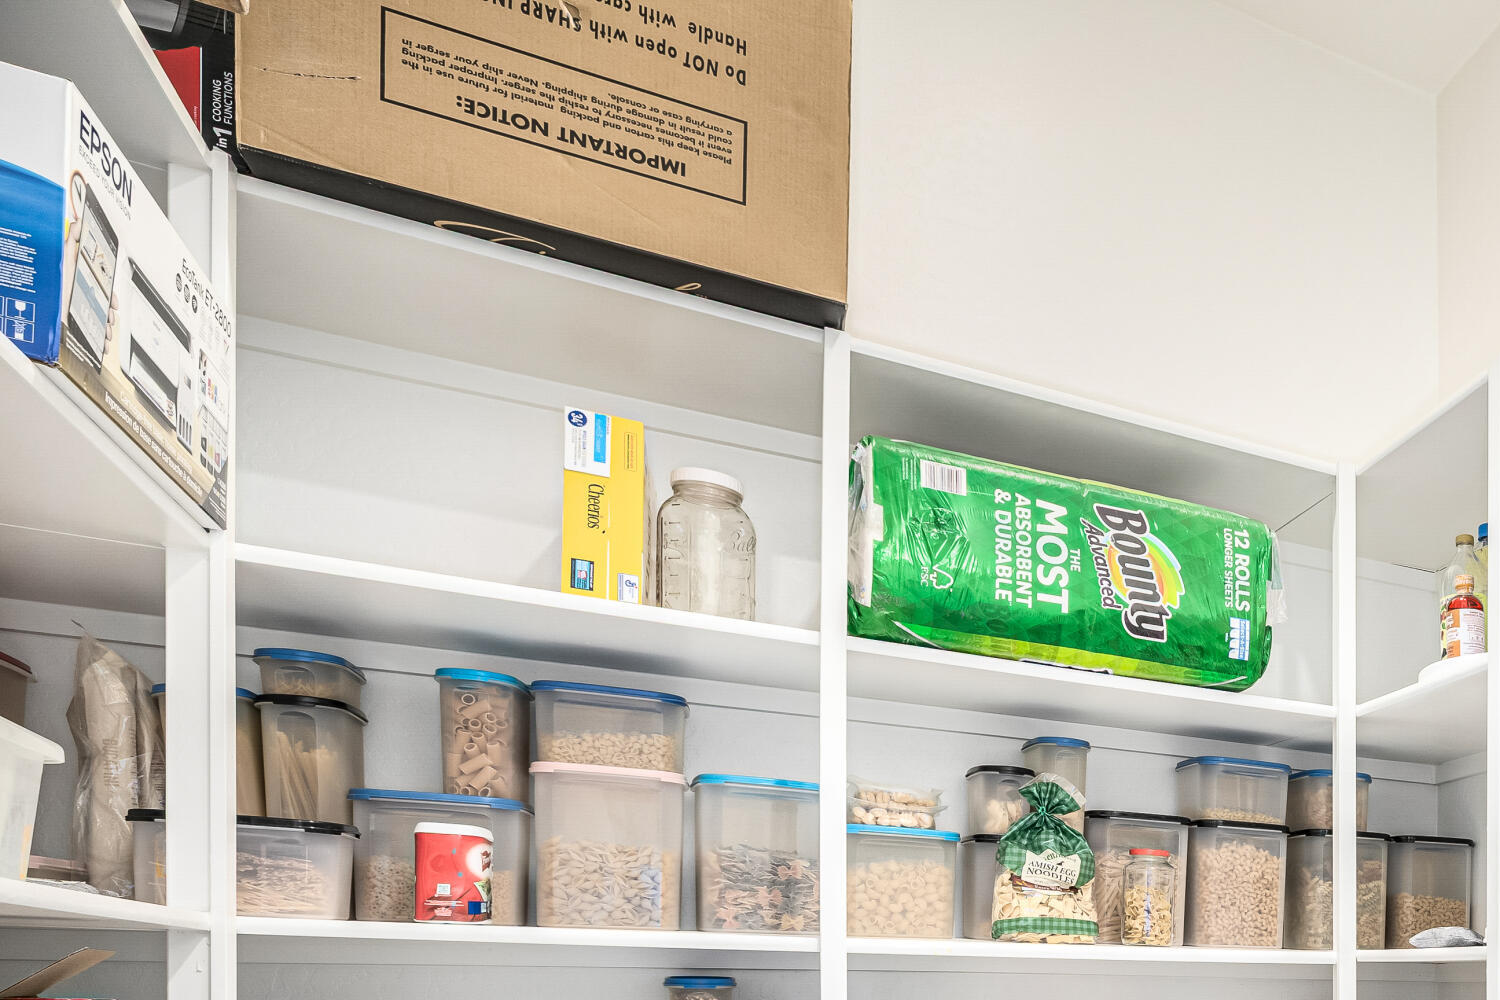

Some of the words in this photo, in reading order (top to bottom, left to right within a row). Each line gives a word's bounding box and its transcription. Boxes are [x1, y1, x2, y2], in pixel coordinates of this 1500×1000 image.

[521, 1, 581, 32] SHARP
[638, 4, 676, 28] with
[589, 20, 628, 43] with
[688, 21, 747, 56] Handle
[402, 38, 412, 49] in
[415, 43, 450, 58] serger
[635, 35, 677, 58] open
[401, 59, 419, 70] the
[402, 47, 446, 67] packing
[453, 55, 479, 67] your
[683, 52, 719, 77] NOT
[423, 65, 433, 75] in
[436, 70, 454, 80] use
[448, 64, 498, 85] Improper
[482, 63, 504, 76] ship
[725, 65, 746, 86] Do
[458, 76, 490, 92] future
[501, 79, 536, 95] serger.
[507, 72, 538, 88] Never
[212, 79, 222, 122] COOKING
[223, 72, 233, 125] FUNCTIONS
[492, 87, 508, 98] for
[511, 92, 554, 110] material
[539, 91, 555, 102] the
[542, 82, 588, 102] shipping.
[558, 96, 589, 111] reship
[591, 96, 623, 113] during
[608, 93, 647, 110] console.
[456, 95, 549, 137] NOTICE:
[560, 106, 600, 124] packing
[592, 108, 602, 116] to
[605, 110, 652, 130] necessary
[626, 108, 665, 126] damage
[662, 111, 683, 121] case
[603, 120, 622, 130] and
[625, 127, 655, 140] carton
[668, 121, 677, 131] in
[679, 125, 705, 137] result
[686, 116, 724, 133] carrying
[655, 125, 696, 146] becomes
[658, 137, 674, 147] this
[698, 140, 704, 148] it
[708, 134, 732, 145] could
[557, 127, 686, 177] IMPORTANT
[677, 142, 700, 156] keep
[707, 143, 732, 154] event
[79, 109, 134, 207] EPSON
[703, 151, 732, 165] Please
[181, 258, 205, 298] EcoTank
[204, 288, 232, 338] ET-2800
[994, 488, 1011, 504] &
[587, 483, 605, 530] Cheerios
[1234, 528, 1250, 549] 12
[994, 509, 1013, 602] DURABLE
[1014, 492, 1032, 609] ABSORBENT
[1035, 498, 1069, 614] MOST
[1223, 527, 1234, 569] LONGER
[1070, 548, 1081, 572] THE
[1079, 517, 1123, 610] Advanced
[920, 565, 929, 587] FSC
[1093, 503, 1173, 642] Bounty
[1223, 570, 1234, 608] SHEETS
[1234, 552, 1251, 612] ROLLS
[1026, 867, 1075, 885] NOODLES
[1028, 860, 1058, 872] AMISH
[1060, 867, 1076, 877] EGG
